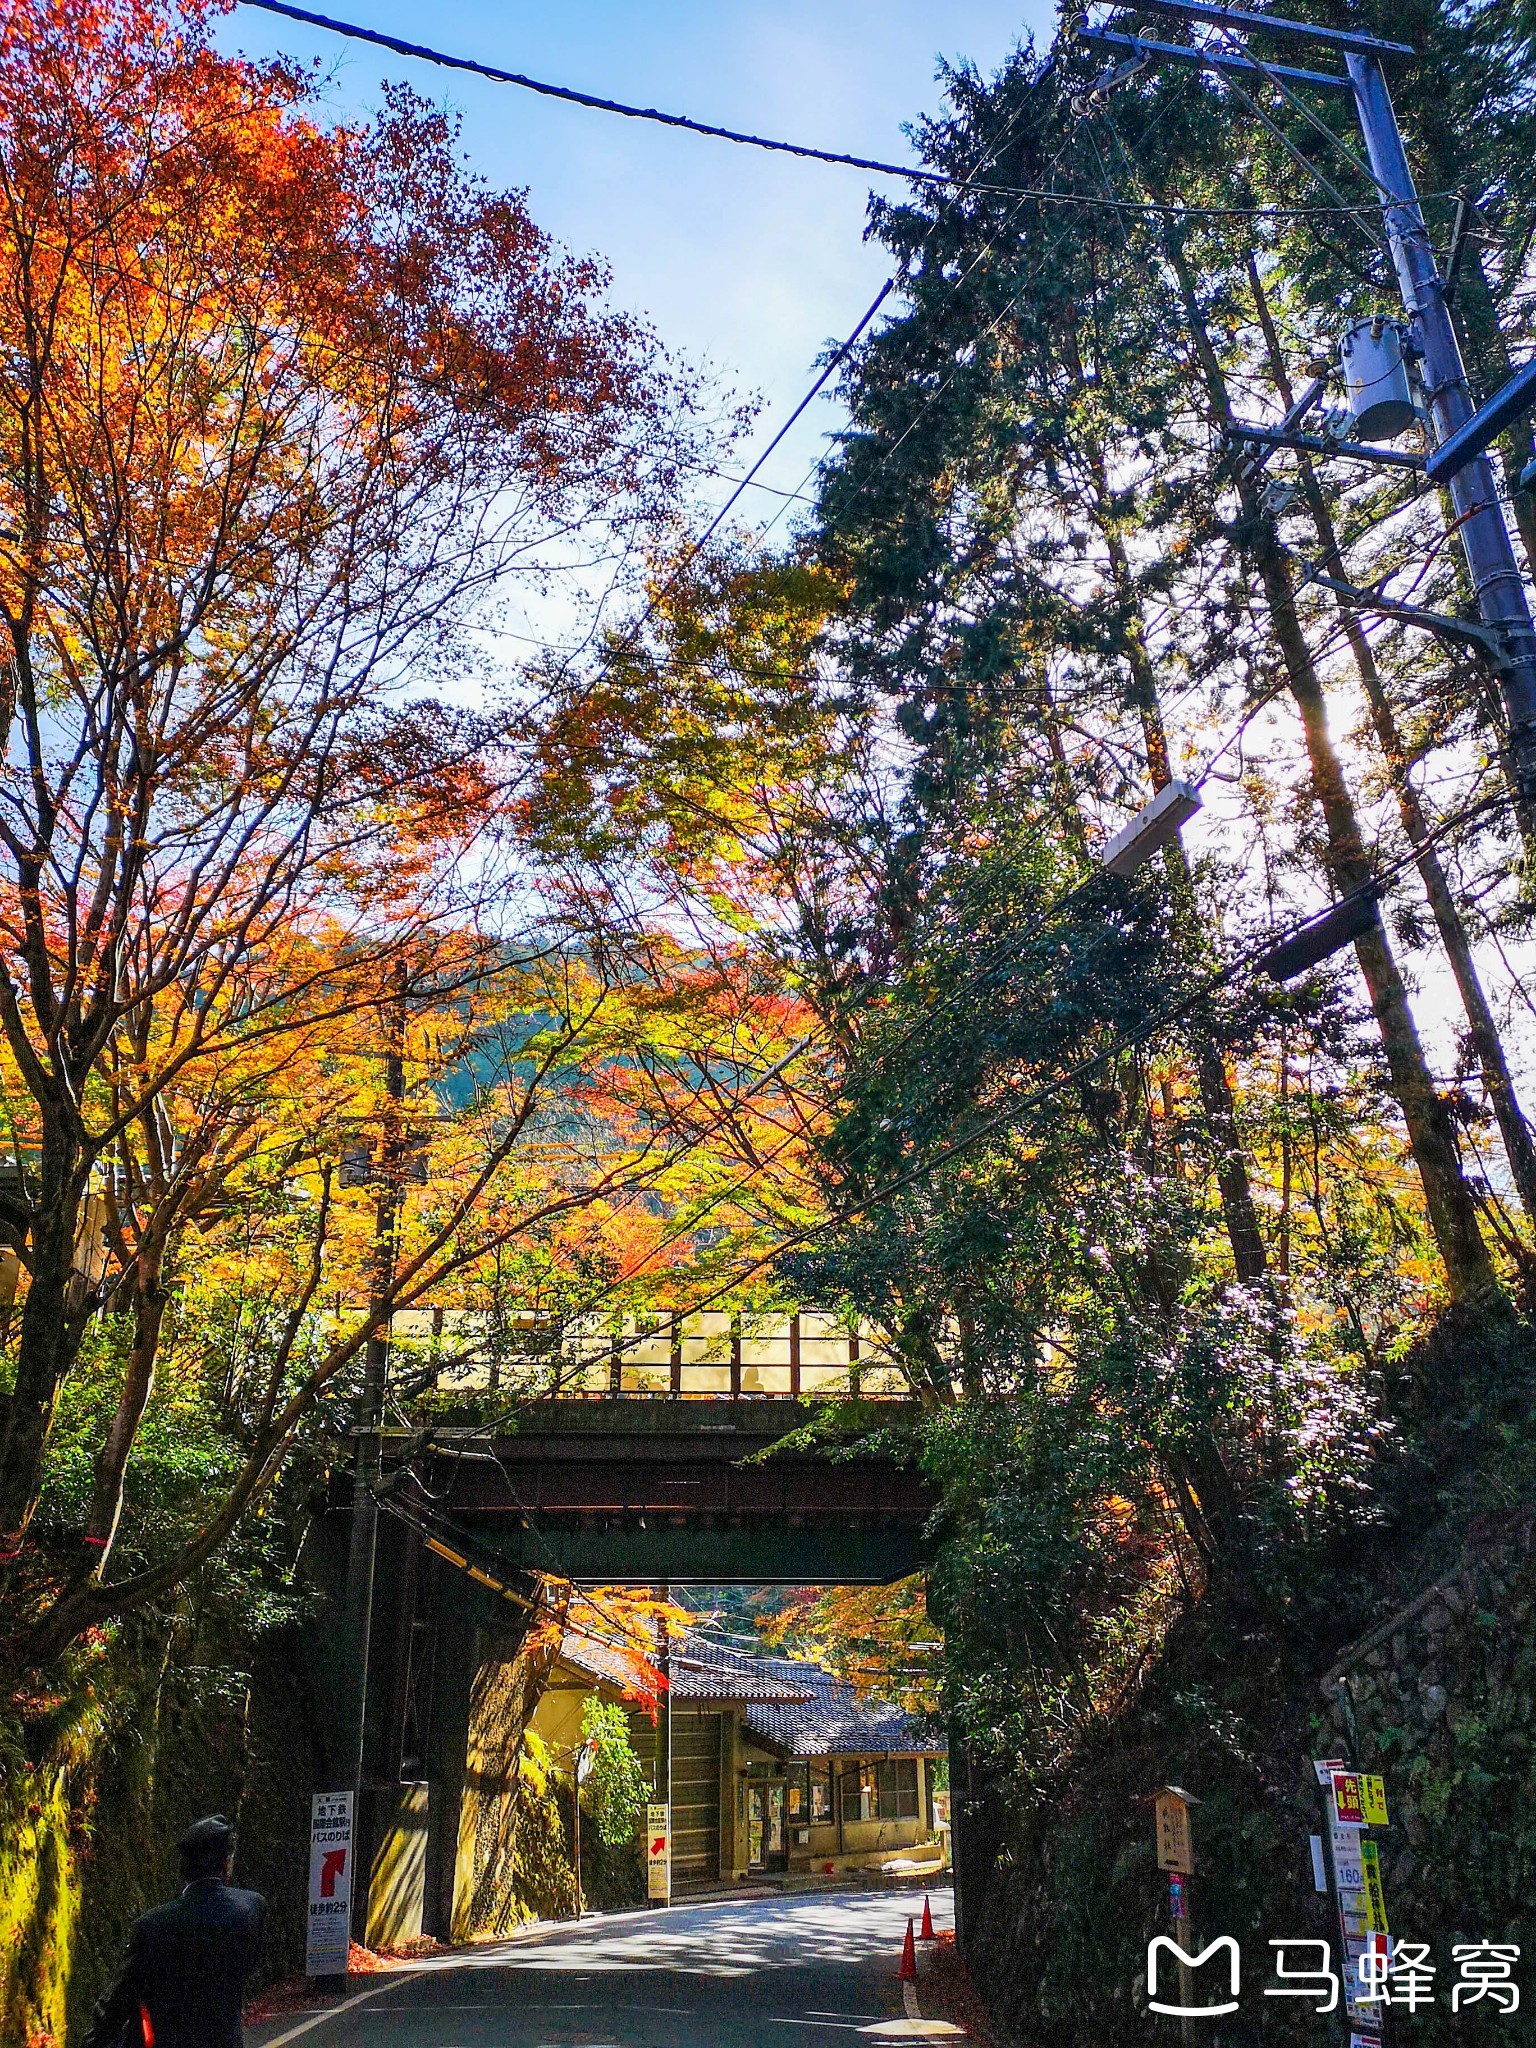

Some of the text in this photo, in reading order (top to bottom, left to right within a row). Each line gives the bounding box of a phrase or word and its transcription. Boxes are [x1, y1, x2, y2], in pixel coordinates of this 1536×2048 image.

[1345, 1779, 1359, 1810] 先頭
[1374, 1779, 1384, 1811] 一列で
[317, 1804, 347, 1817] 地下鉄
[312, 1830, 350, 1843] バスのりば
[310, 1901, 348, 1916] 徒歩約2分
